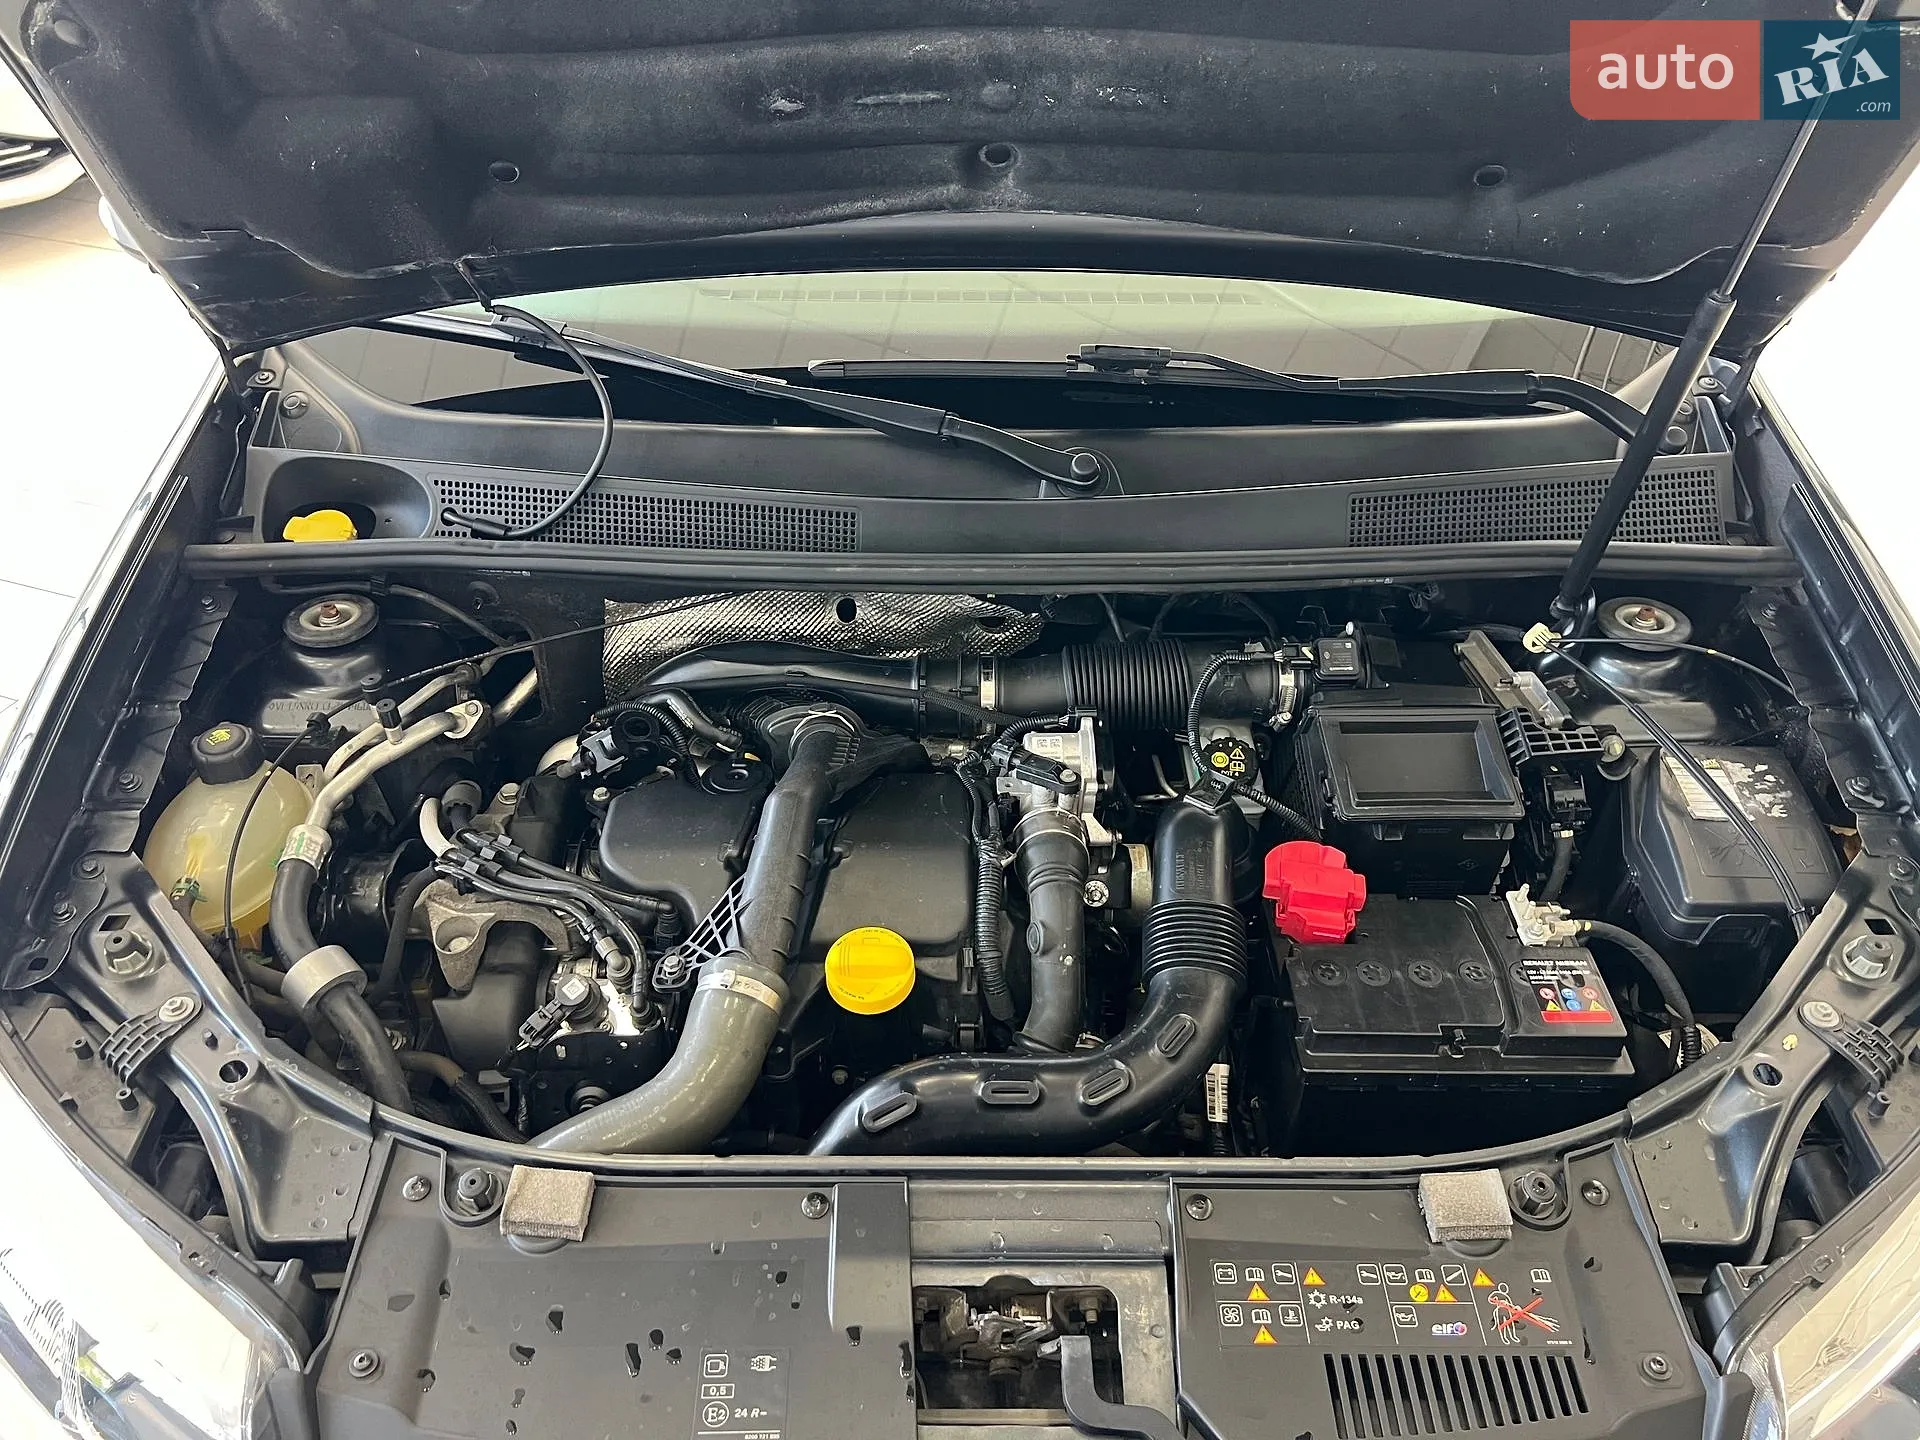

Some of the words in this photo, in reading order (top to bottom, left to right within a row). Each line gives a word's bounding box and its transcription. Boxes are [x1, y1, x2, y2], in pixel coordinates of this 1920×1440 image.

[1329, 1294, 1364, 1305] R-134a
[1336, 1320, 1360, 1330] PAG
[1431, 1322, 1454, 1335] elf
[710, 1387, 727, 1396] 0,5
[707, 1407, 726, 1423] E2
[734, 1408, 748, 1418] 24
